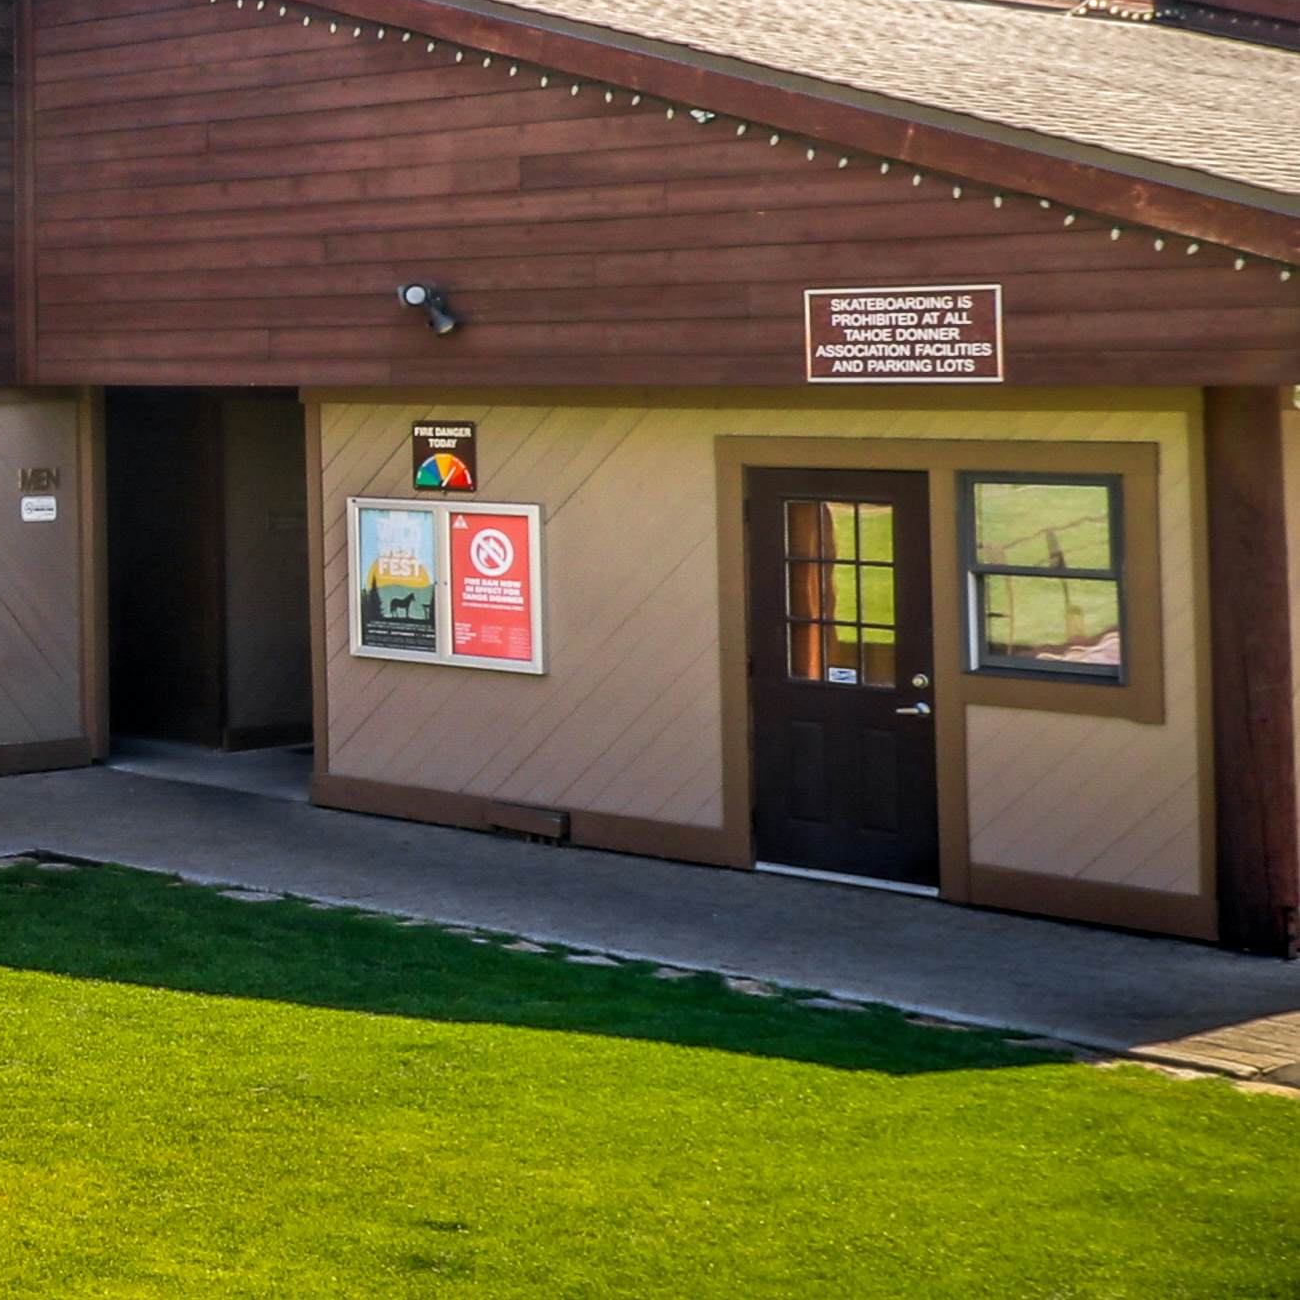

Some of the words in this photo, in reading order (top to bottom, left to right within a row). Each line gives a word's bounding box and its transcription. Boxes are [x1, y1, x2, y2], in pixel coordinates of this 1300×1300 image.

[830, 296, 954, 312] SKATEBOARDING
[957, 295, 973, 309] IS
[831, 312, 918, 327] PROHIBITED
[921, 311, 940, 325] AT
[943, 311, 973, 325] ALL
[843, 328, 893, 342] TAHOE
[895, 327, 961, 342] DONNER
[815, 343, 911, 358] ASSOCIATION
[915, 342, 993, 357] FACILITIES
[831, 360, 864, 373] AND
[867, 359, 933, 373] PARKING
[936, 358, 976, 373] LOTS
[414, 426, 434, 437] FIRE
[435, 426, 472, 438] DANGER
[428, 438, 457, 449] TODAY
[378, 558, 421, 576] FEST
